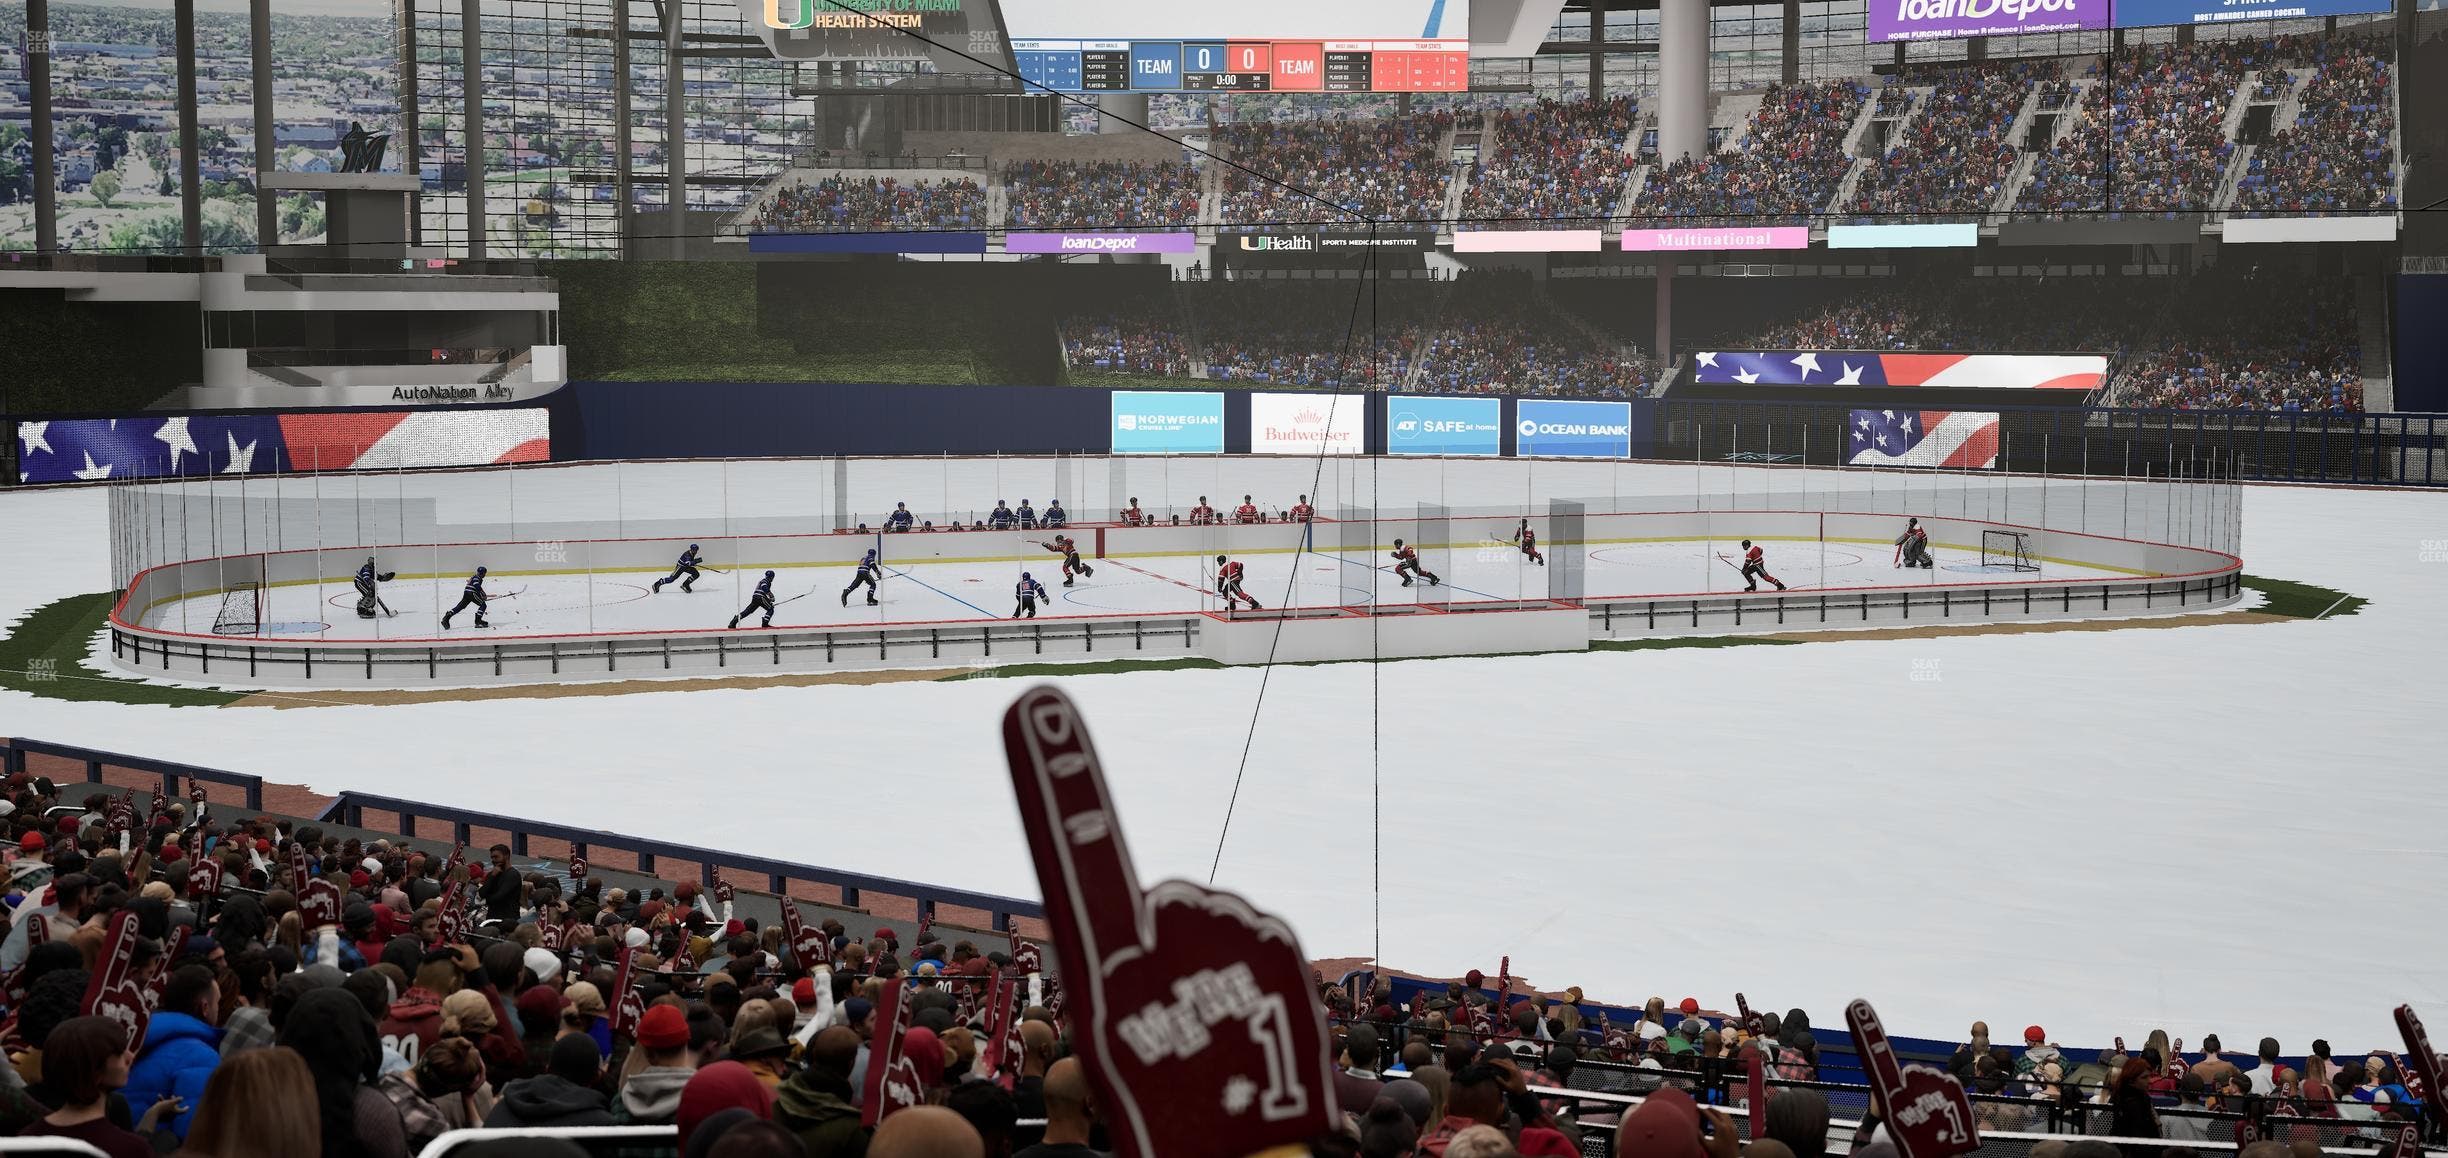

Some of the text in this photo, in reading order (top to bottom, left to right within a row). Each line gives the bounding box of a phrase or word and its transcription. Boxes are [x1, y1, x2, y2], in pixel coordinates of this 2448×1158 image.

[816, 15, 921, 28] HEALTH SYSTEM
[1911, 29, 1952, 38] PURCHASE
[1957, 27, 1977, 35] Home
[1198, 48, 1210, 69] 0
[1243, 48, 1255, 69] 0
[1137, 59, 1172, 74] TEAM
[1280, 60, 1314, 74] TEAM
[1216, 74, 1237, 85] 0:00
[1062, 235, 1137, 251] loanDepot
[1656, 232, 1771, 247] Multinational
[392, 385, 477, 400] AutoNation
[1138, 415, 1219, 425] NORWEGIAN
[1396, 420, 1417, 431] ADT
[1423, 420, 1466, 432] SAFE
[1475, 423, 1497, 431] home
[1264, 427, 1350, 441] Budweiser
[1539, 424, 1628, 436] OCEAN BANK
